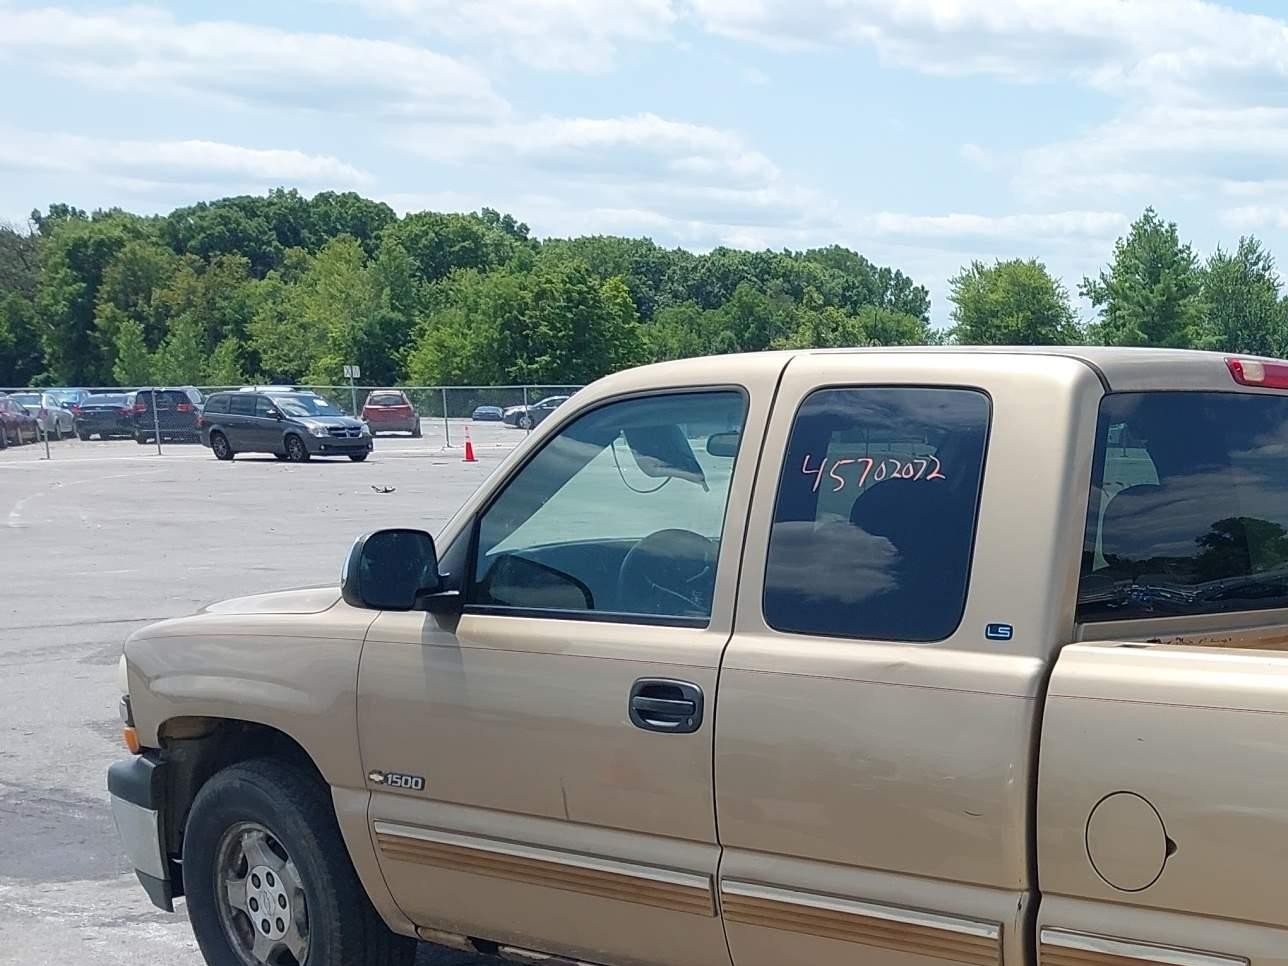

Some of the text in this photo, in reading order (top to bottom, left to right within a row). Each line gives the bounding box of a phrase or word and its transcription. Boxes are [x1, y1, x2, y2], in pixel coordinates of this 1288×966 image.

[802, 455, 945, 491] 45702072
[987, 626, 1010, 638] LS
[387, 774, 422, 789] 1500
